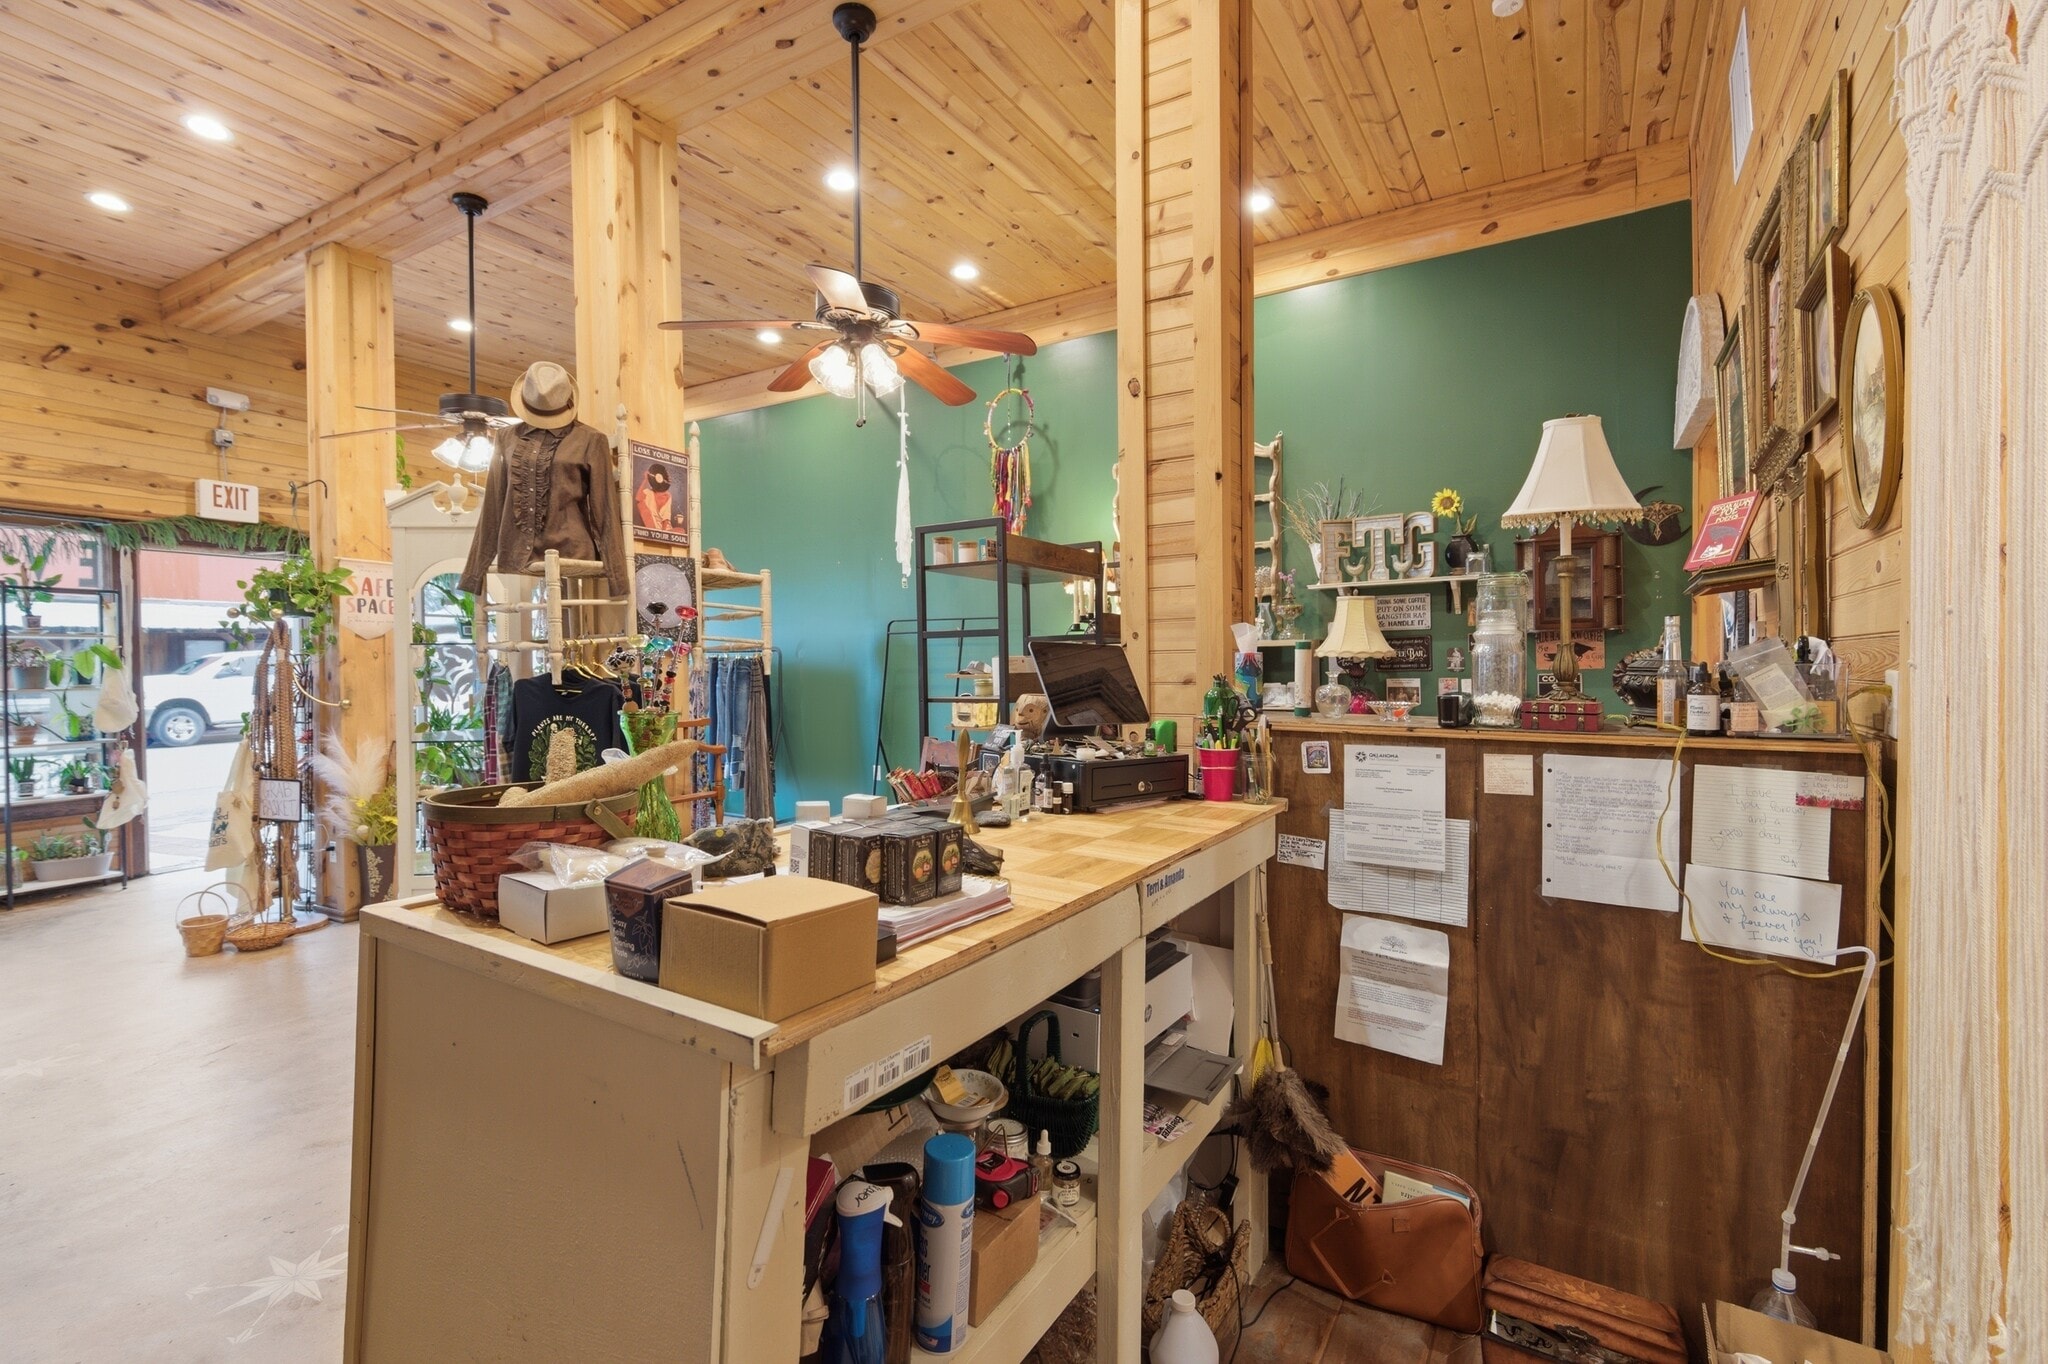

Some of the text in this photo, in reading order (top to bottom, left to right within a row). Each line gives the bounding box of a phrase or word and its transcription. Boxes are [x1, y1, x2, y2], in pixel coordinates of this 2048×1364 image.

[651, 450, 671, 460] YOUR
[212, 483, 249, 512] EXIT
[1719, 505, 1738, 517] POE
[650, 531, 670, 541] YOUR
[671, 534, 688, 544] SOUL
[346, 575, 394, 598] SAFE
[345, 597, 394, 615] SPACE
[1377, 603, 1427, 613] PUT ON SOME
[1377, 612, 1411, 620] GANGSTER
[1378, 620, 1385, 628] &
[531, 717, 551, 737] PLANTS
[575, 717, 598, 742] THERAPY
[1719, 880, 1777, 903] You are
[1718, 901, 1811, 927] my always
[1746, 930, 1763, 941] I
